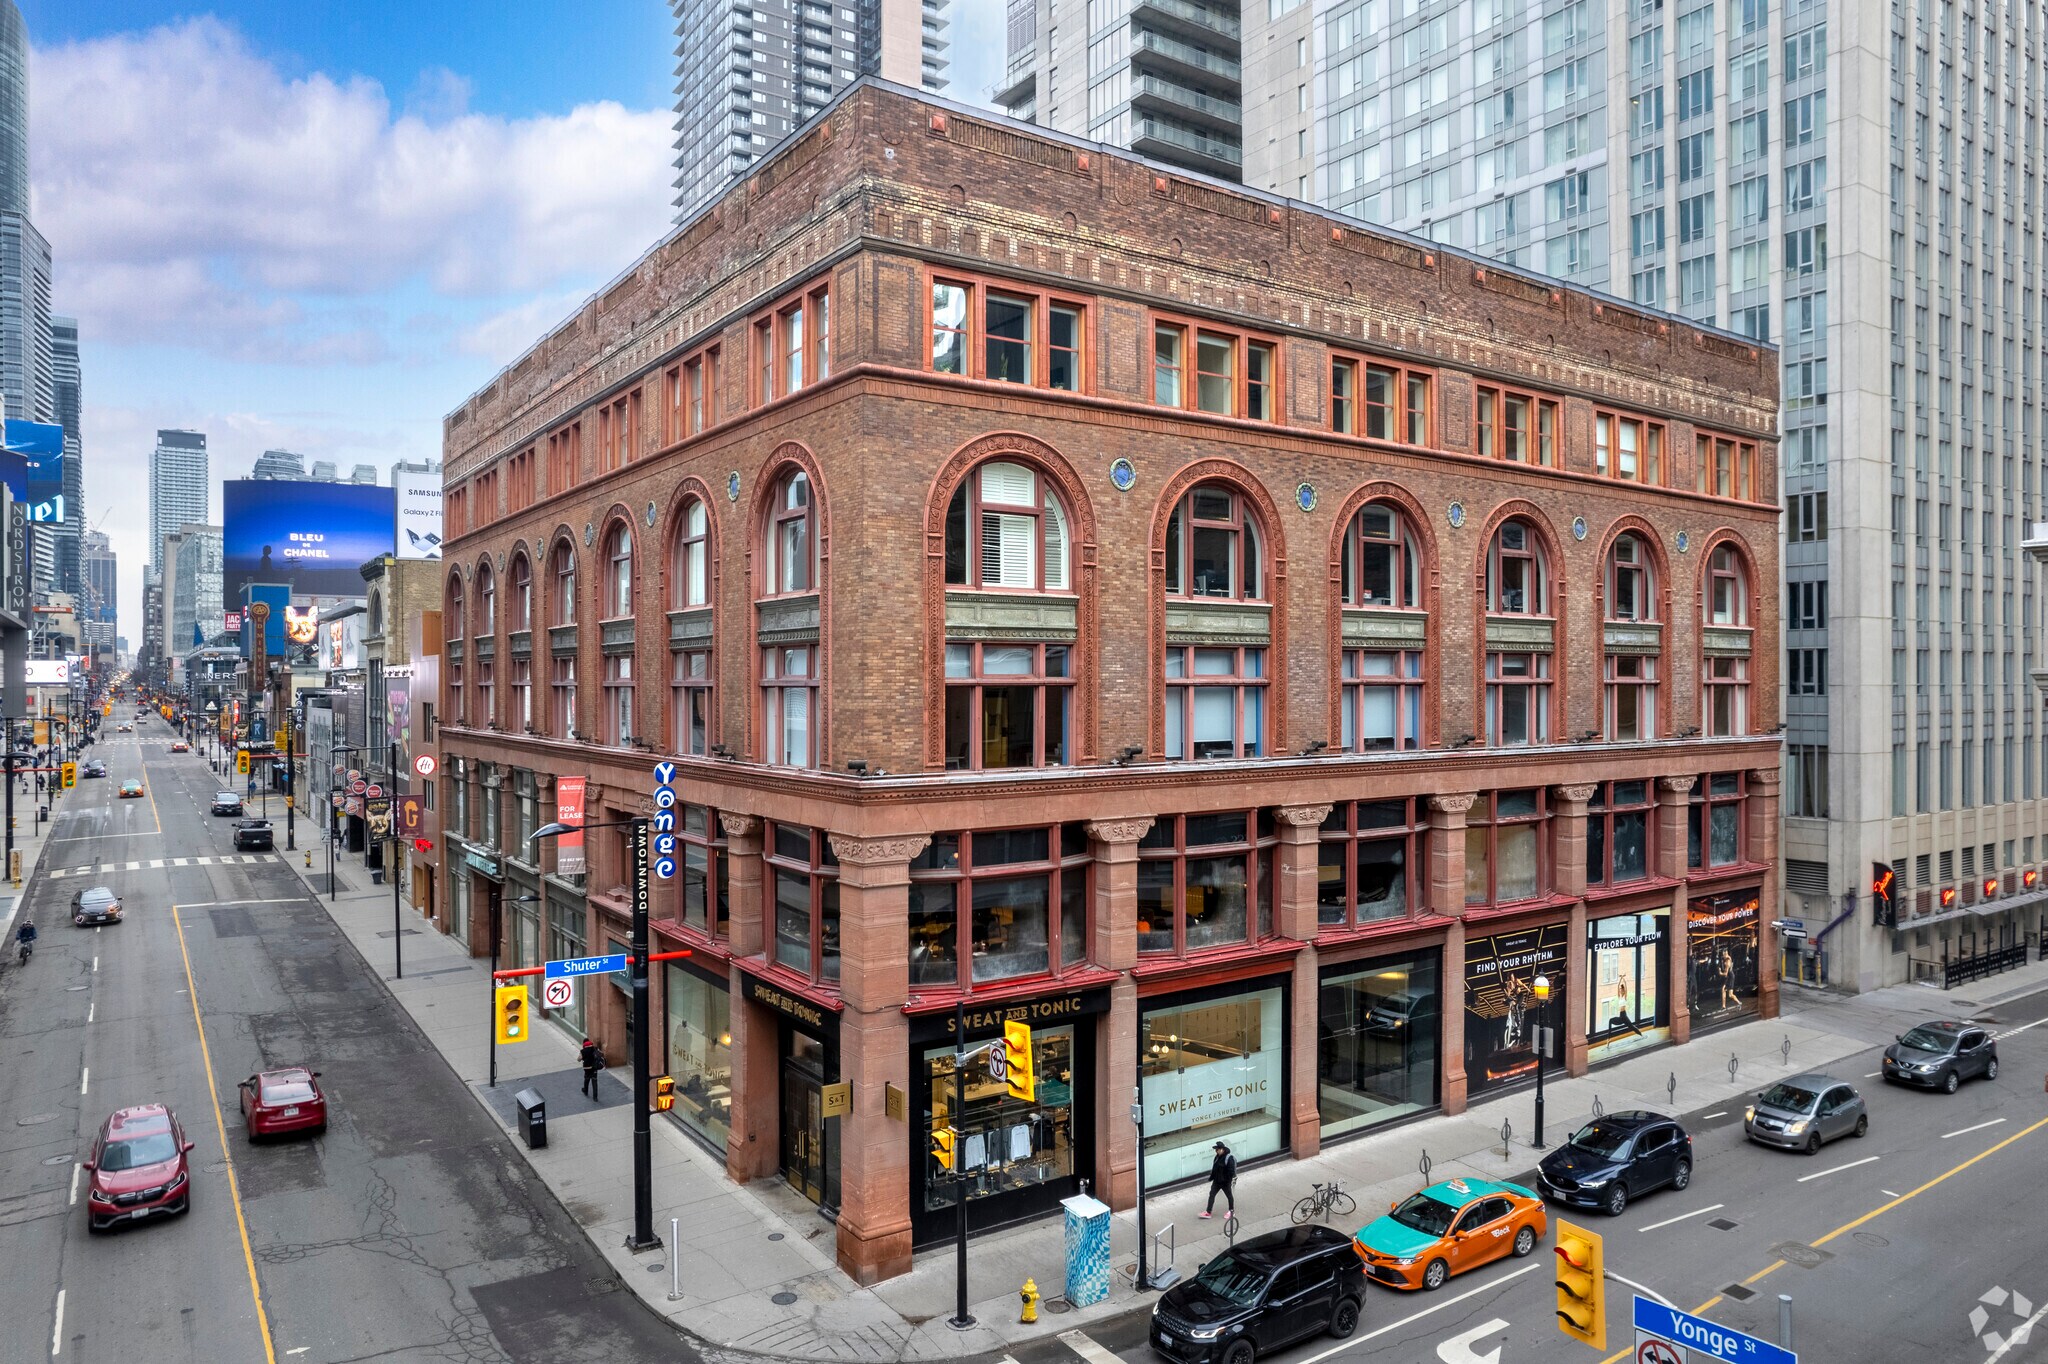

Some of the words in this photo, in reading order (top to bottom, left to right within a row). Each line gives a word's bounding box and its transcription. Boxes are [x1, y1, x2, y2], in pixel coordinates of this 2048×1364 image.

[408, 488, 442, 498] SAMSUN
[403, 508, 429, 517] Galaxy
[430, 509, 435, 517] Z
[289, 533, 324, 542] BLEU
[12, 505, 25, 609] NORDSTROM
[283, 548, 329, 558] CHANEL
[226, 614, 240, 623] JAC
[295, 692, 303, 731] Yonge
[253, 723, 262, 735] R
[654, 762, 676, 879] Yonge
[639, 825, 647, 911] DOWNTOWN
[1688, 916, 1717, 929] DISCOVER
[1718, 912, 1734, 922] YOUR
[1735, 908, 1753, 919] POWER
[1594, 938, 1624, 952] EXPLORE
[1625, 935, 1643, 946] YOUR
[1645, 930, 1662, 941] FLOW
[563, 960, 601, 974] Shuter
[1476, 962, 1496, 974] FIND
[1499, 957, 1520, 969] YOUR
[1522, 950, 1553, 965] RHYTHM
[754, 984, 781, 1007] SWEAT
[947, 1010, 1002, 1032] SWEAT
[1006, 1009, 1028, 1020] AND
[1031, 997, 1081, 1018] TONIC
[673, 1044, 694, 1066] SWEAT
[704, 1063, 724, 1080] TONIC
[1159, 1095, 1204, 1116] SWEAT
[1208, 1093, 1222, 1101] AND
[1227, 1080, 1267, 1100] TONIC
[1192, 1114, 1211, 1123] YONGE
[1219, 1107, 1240, 1116] SHUTER
[1670, 1311, 1738, 1356] Yonge
[1744, 1339, 1756, 1354] St
